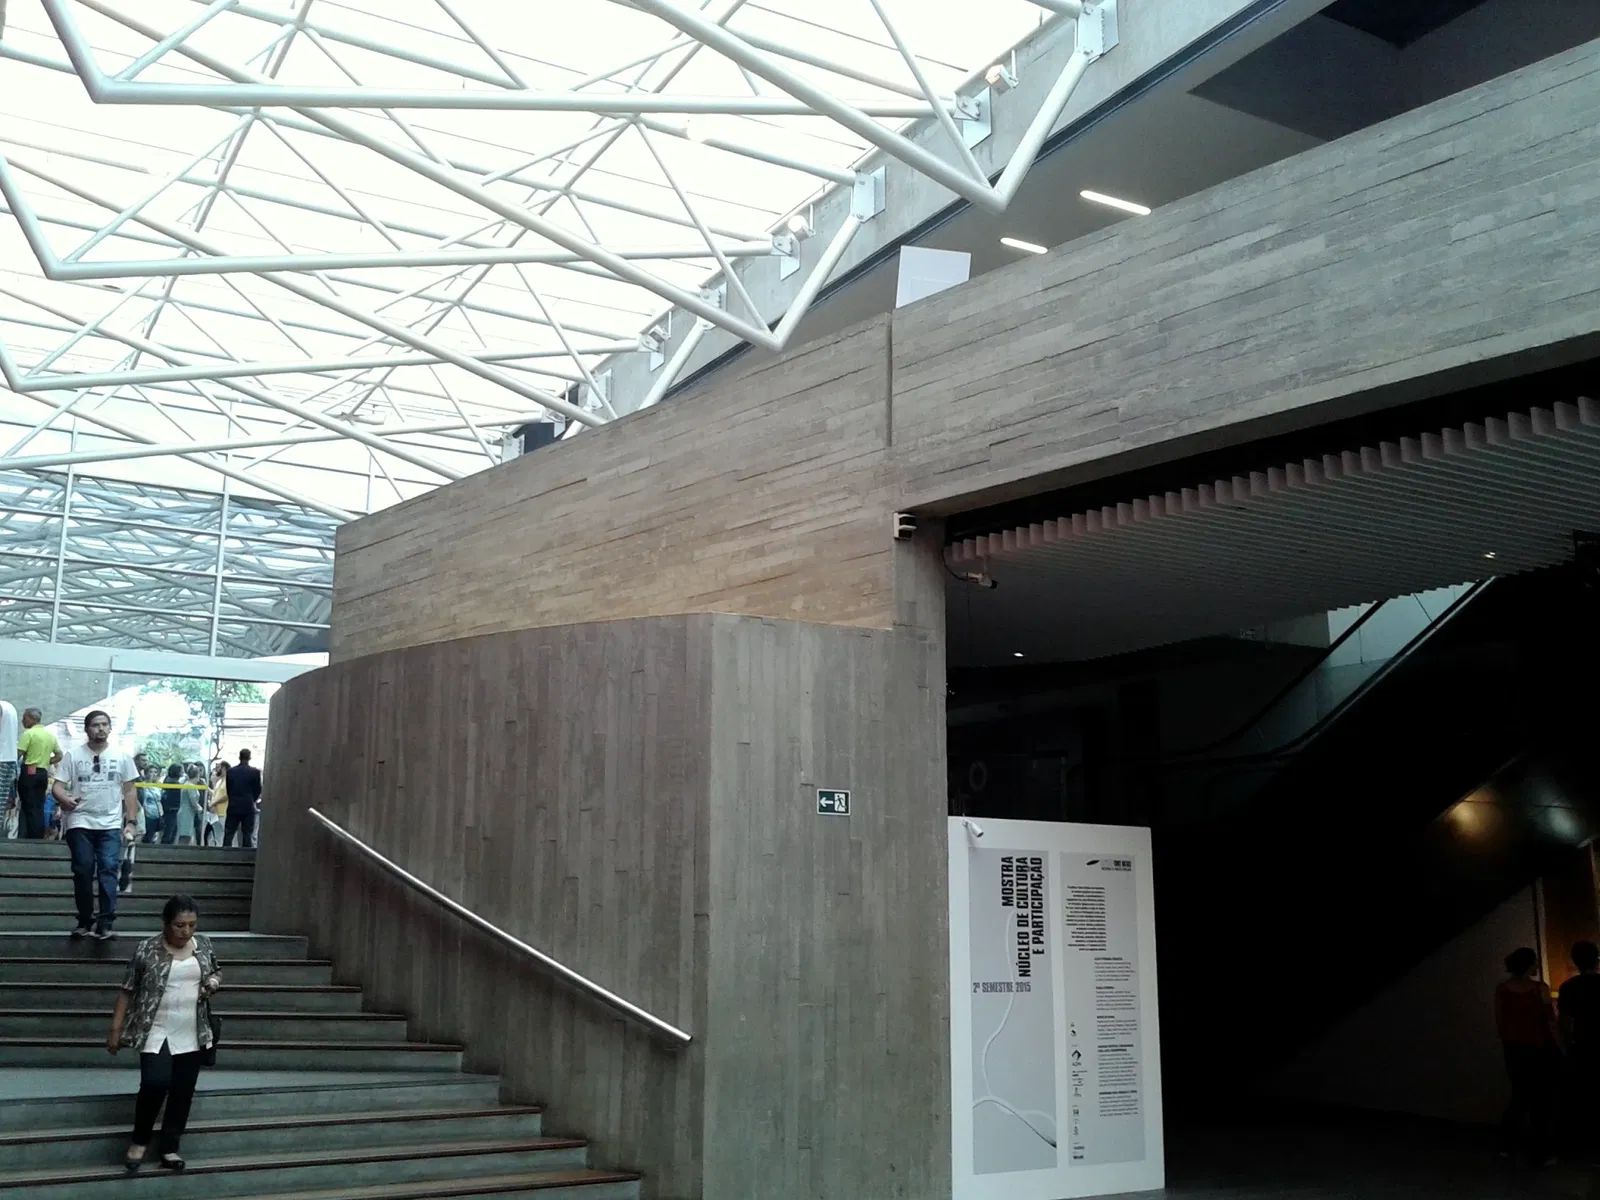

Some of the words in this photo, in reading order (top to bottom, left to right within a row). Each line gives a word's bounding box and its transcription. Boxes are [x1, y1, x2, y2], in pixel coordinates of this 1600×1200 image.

[1001, 856, 1014, 907] MOSTRA
[1016, 857, 1029, 909] CULTURA
[1030, 857, 1045, 945] PARTICIPAÇÃO
[1017, 913, 1029, 928] DE
[1016, 931, 1031, 977] NÚCLEO
[982, 981, 1014, 993] SEMESTRE
[1015, 981, 1032, 993] 2015
